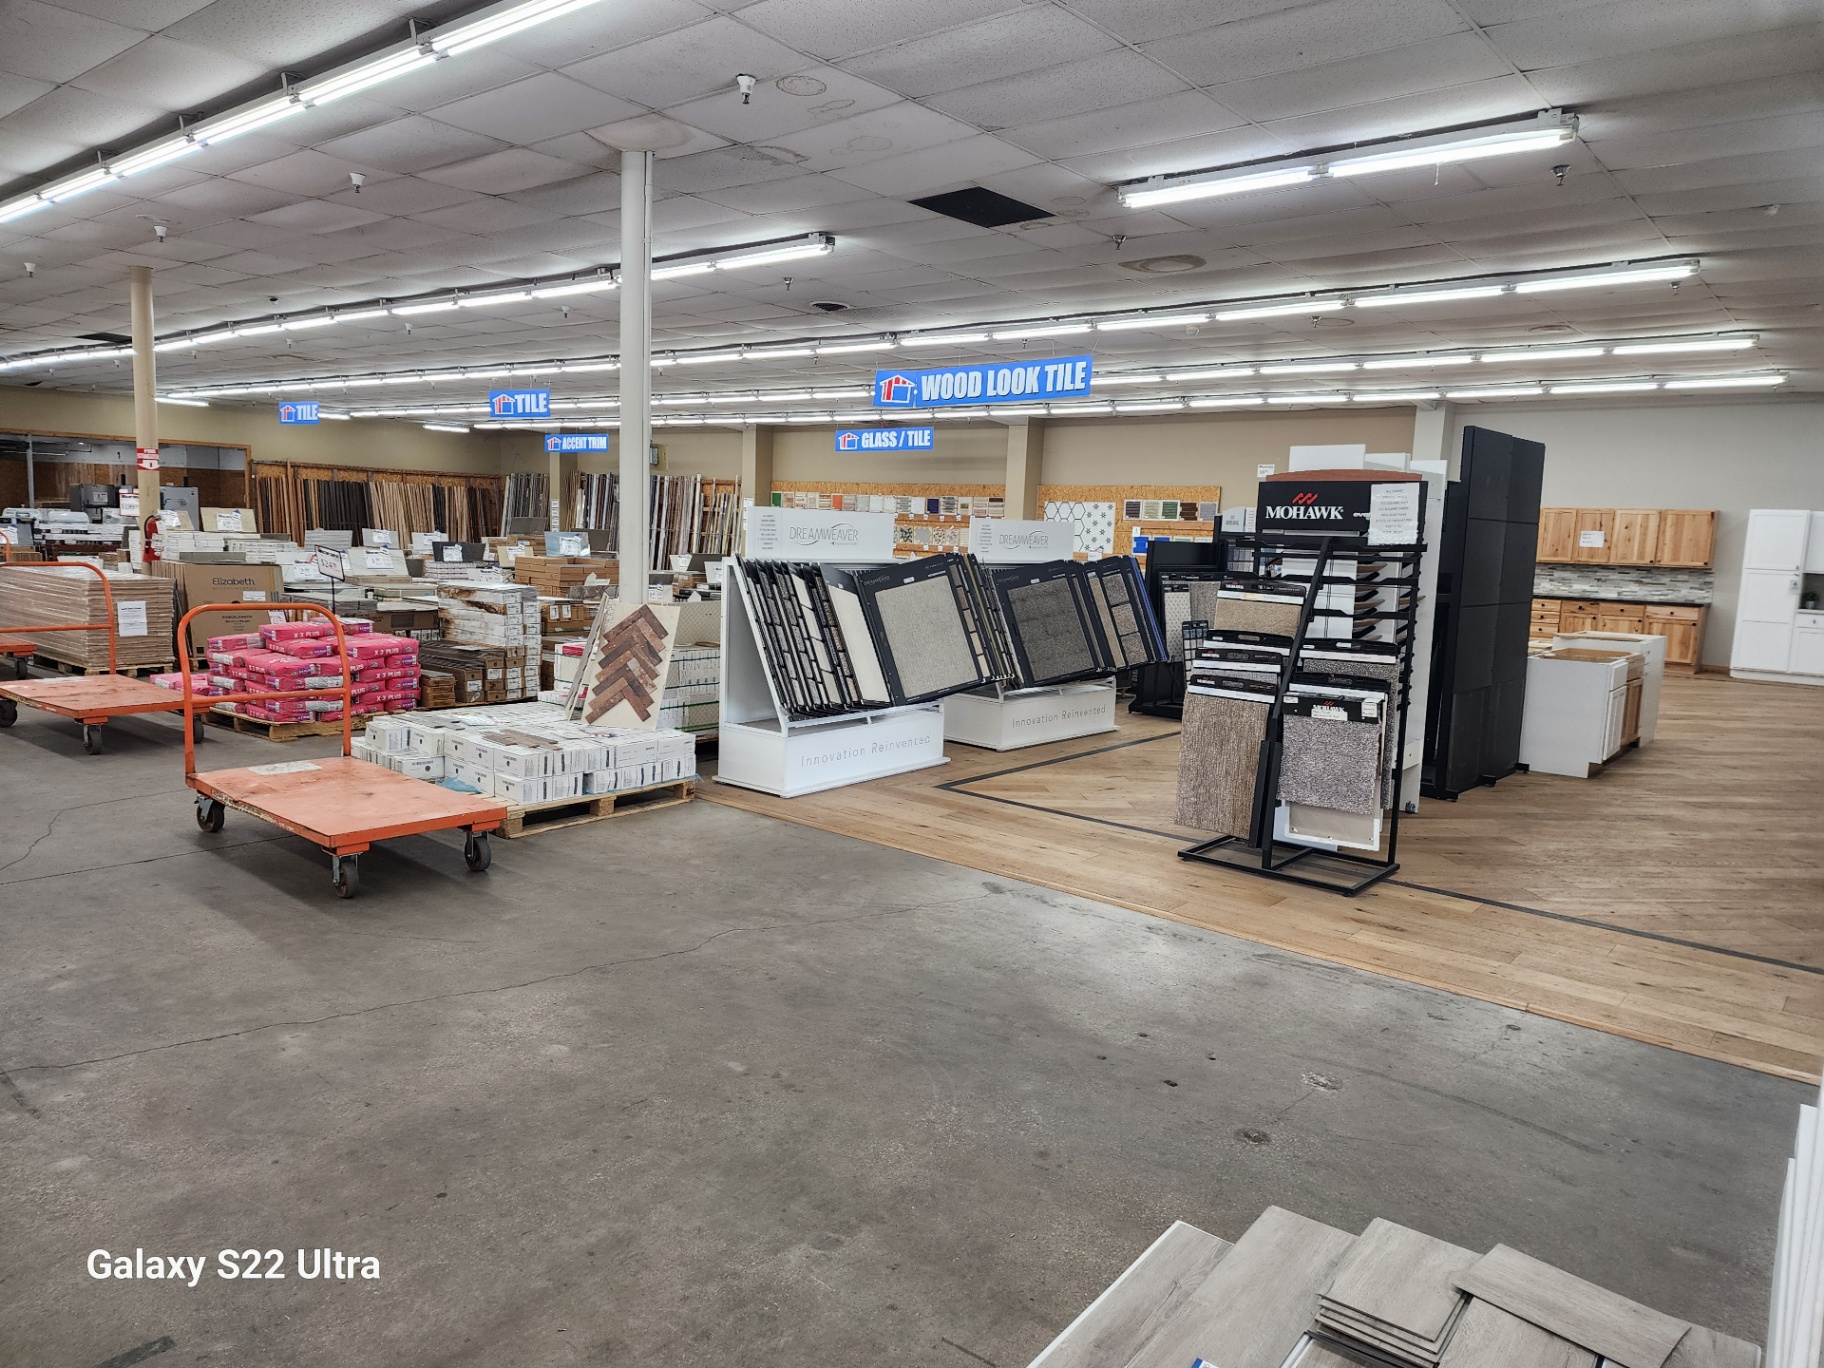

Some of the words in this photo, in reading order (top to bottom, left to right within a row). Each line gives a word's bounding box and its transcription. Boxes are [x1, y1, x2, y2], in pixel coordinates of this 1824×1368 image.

[921, 371, 982, 401] WOOD
[986, 365, 1041, 397] LOOK
[1044, 361, 1087, 393] TILE
[515, 393, 548, 414] TILE
[296, 404, 318, 421] TILE
[562, 436, 587, 450] ACCENT
[587, 436, 608, 449] TRIM
[861, 431, 897, 448] GLASS
[907, 429, 931, 447] TILE
[1265, 505, 1344, 520] MOHAWK
[789, 526, 859, 541] DREAMWEAVER
[999, 534, 1049, 546] DREAMWEAVER
[212, 577, 256, 586] Elizabeth
[350, 663, 364, 671] PLUS
[1012, 713, 1058, 729] Innovation
[1061, 705, 1107, 720] Reinvented
[800, 746, 866, 768] Innovation
[871, 733, 931, 754] Reinvented
